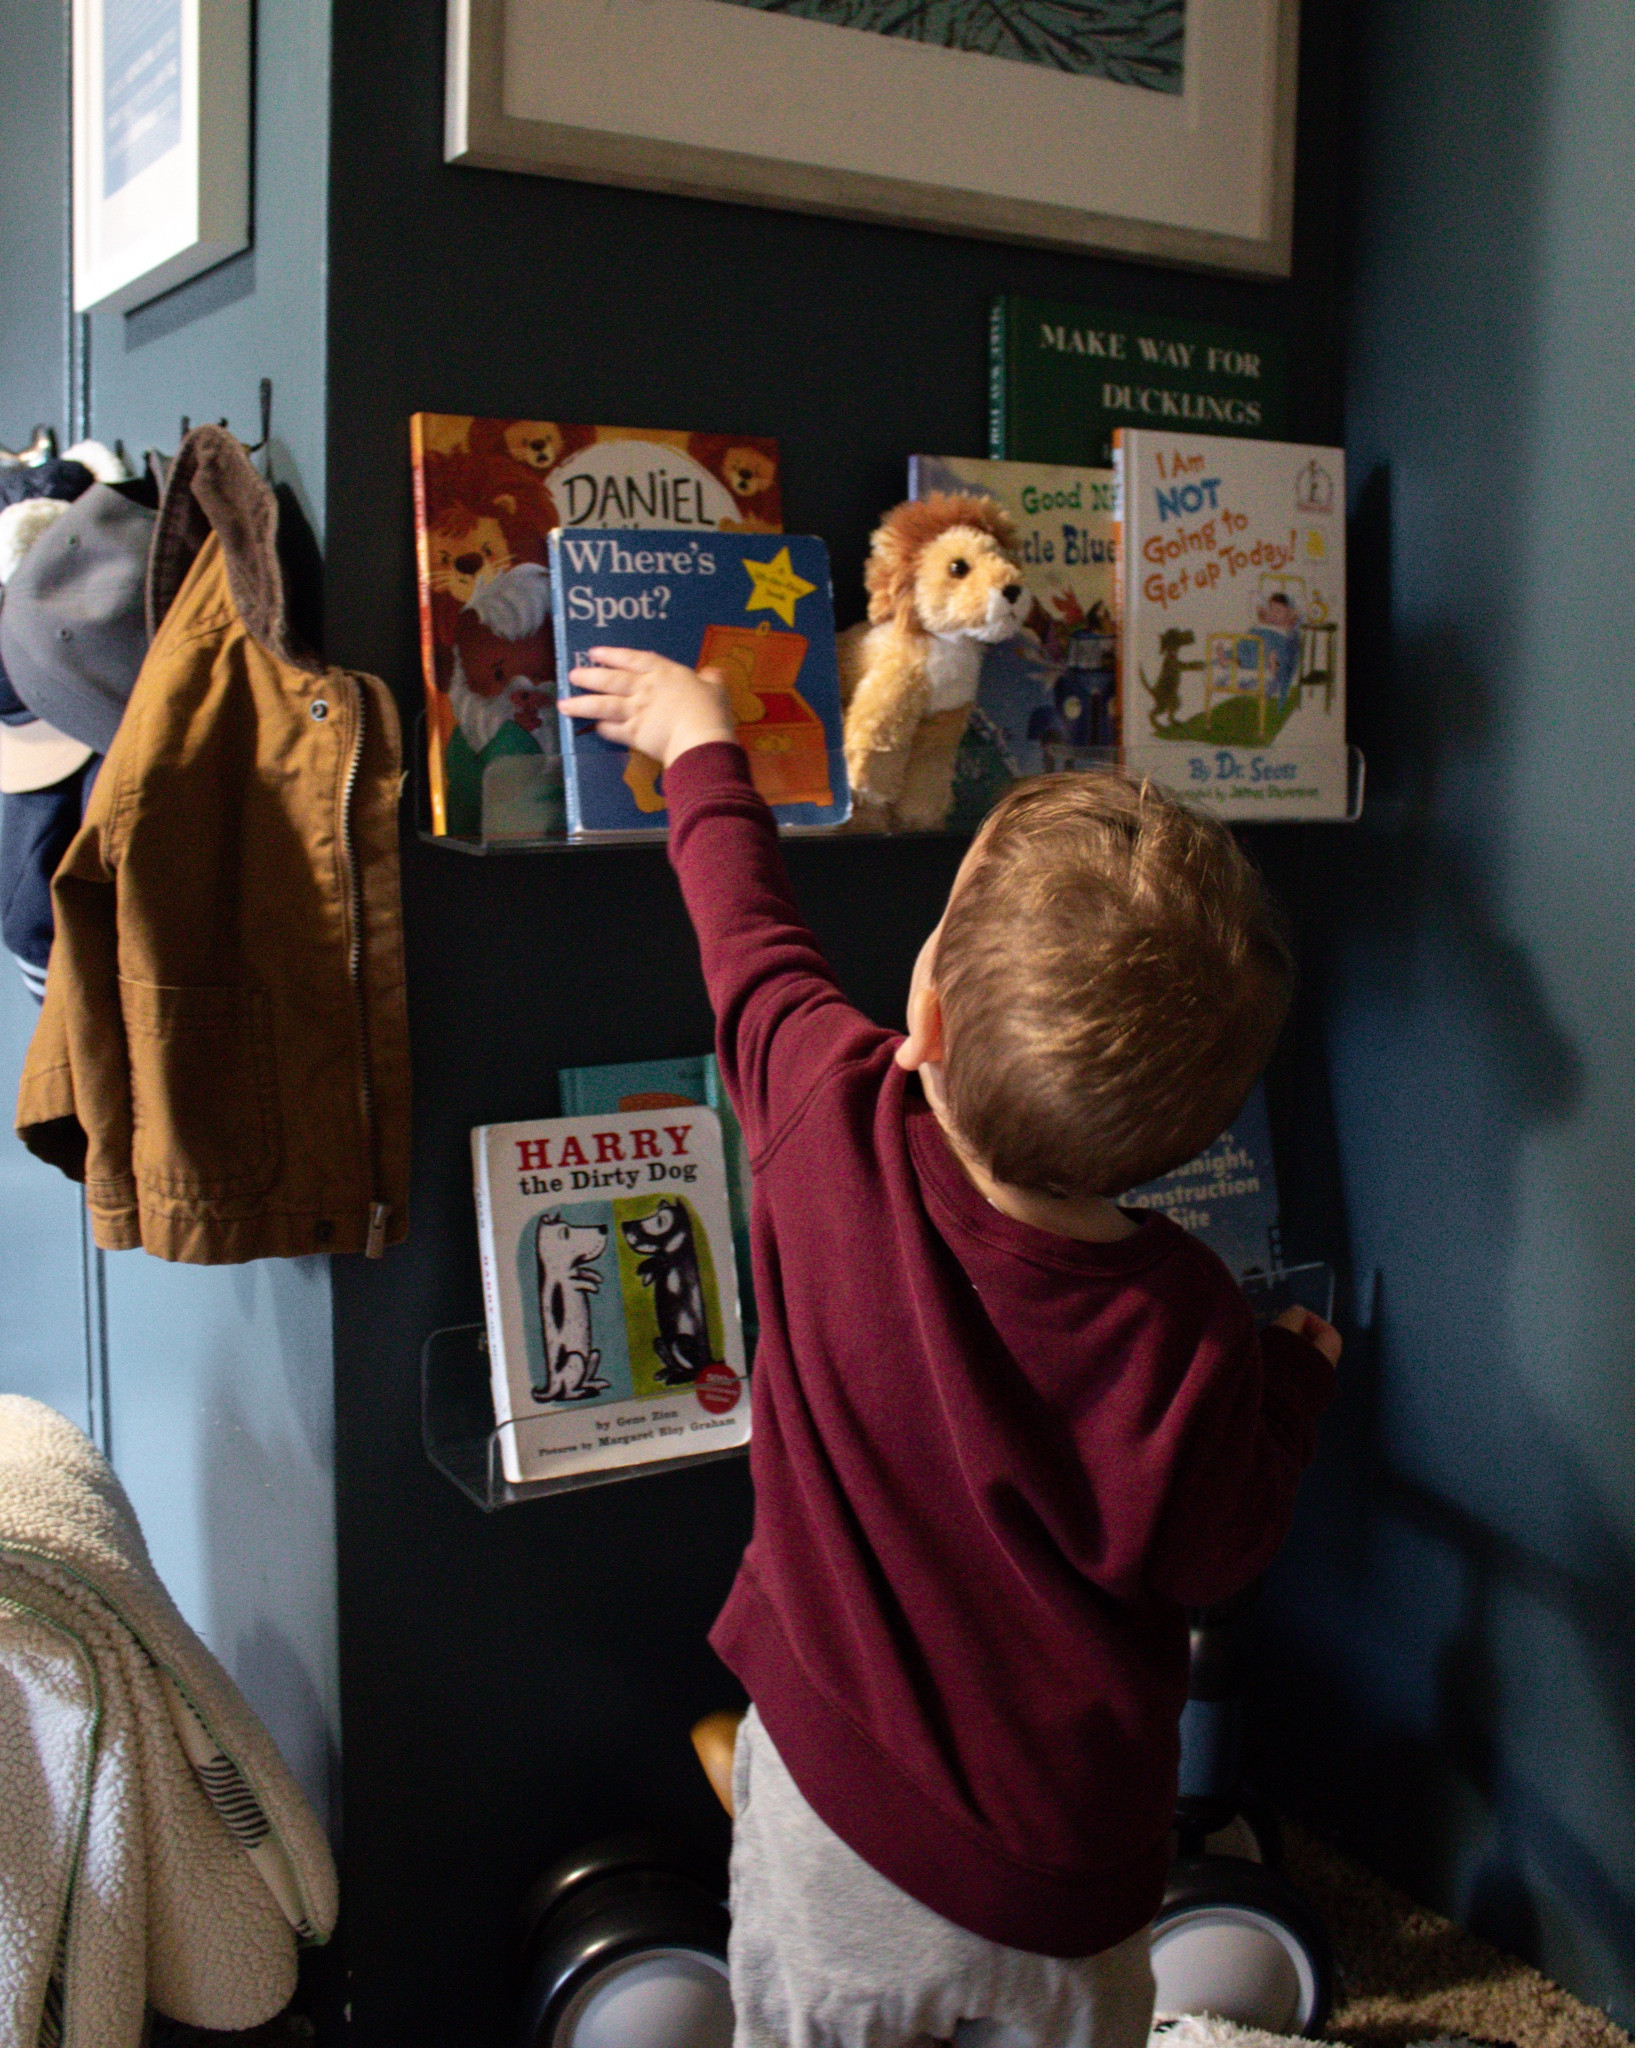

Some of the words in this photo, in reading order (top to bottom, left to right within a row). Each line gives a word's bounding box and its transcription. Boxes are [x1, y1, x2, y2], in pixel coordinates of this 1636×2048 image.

[1040, 324, 1127, 359] MAKE
[1138, 337, 1196, 368] WAY
[1208, 347, 1262, 377] FOR
[1103, 383, 1262, 424] DUCKLINGS
[1156, 451, 1166, 479] I
[1172, 450, 1205, 478] Am
[1022, 482, 1082, 514] Good
[1156, 477, 1221, 522] NOT
[1023, 531, 1054, 563] tle
[1062, 525, 1116, 565] Blue
[1143, 520, 1217, 566] Going
[1222, 508, 1249, 535] to
[563, 540, 717, 575] Where's
[1143, 568, 1189, 610] Get
[1195, 562, 1221, 590] up
[1218, 529, 1297, 576] Today!
[568, 585, 671, 627] Spot?
[1214, 750, 1245, 780] Dr.
[515, 1124, 693, 1171] HARRY
[519, 1175, 563, 1196] the
[570, 1168, 640, 1190] Dirty
[647, 1162, 698, 1183] Dog
[1119, 1174, 1260, 1209] Construction
[595, 1420, 610, 1431] by
[616, 1415, 646, 1428] Gene
[652, 1409, 679, 1421] Zion
[598, 1431, 654, 1447] Margaret
[690, 1417, 736, 1432] Graham
